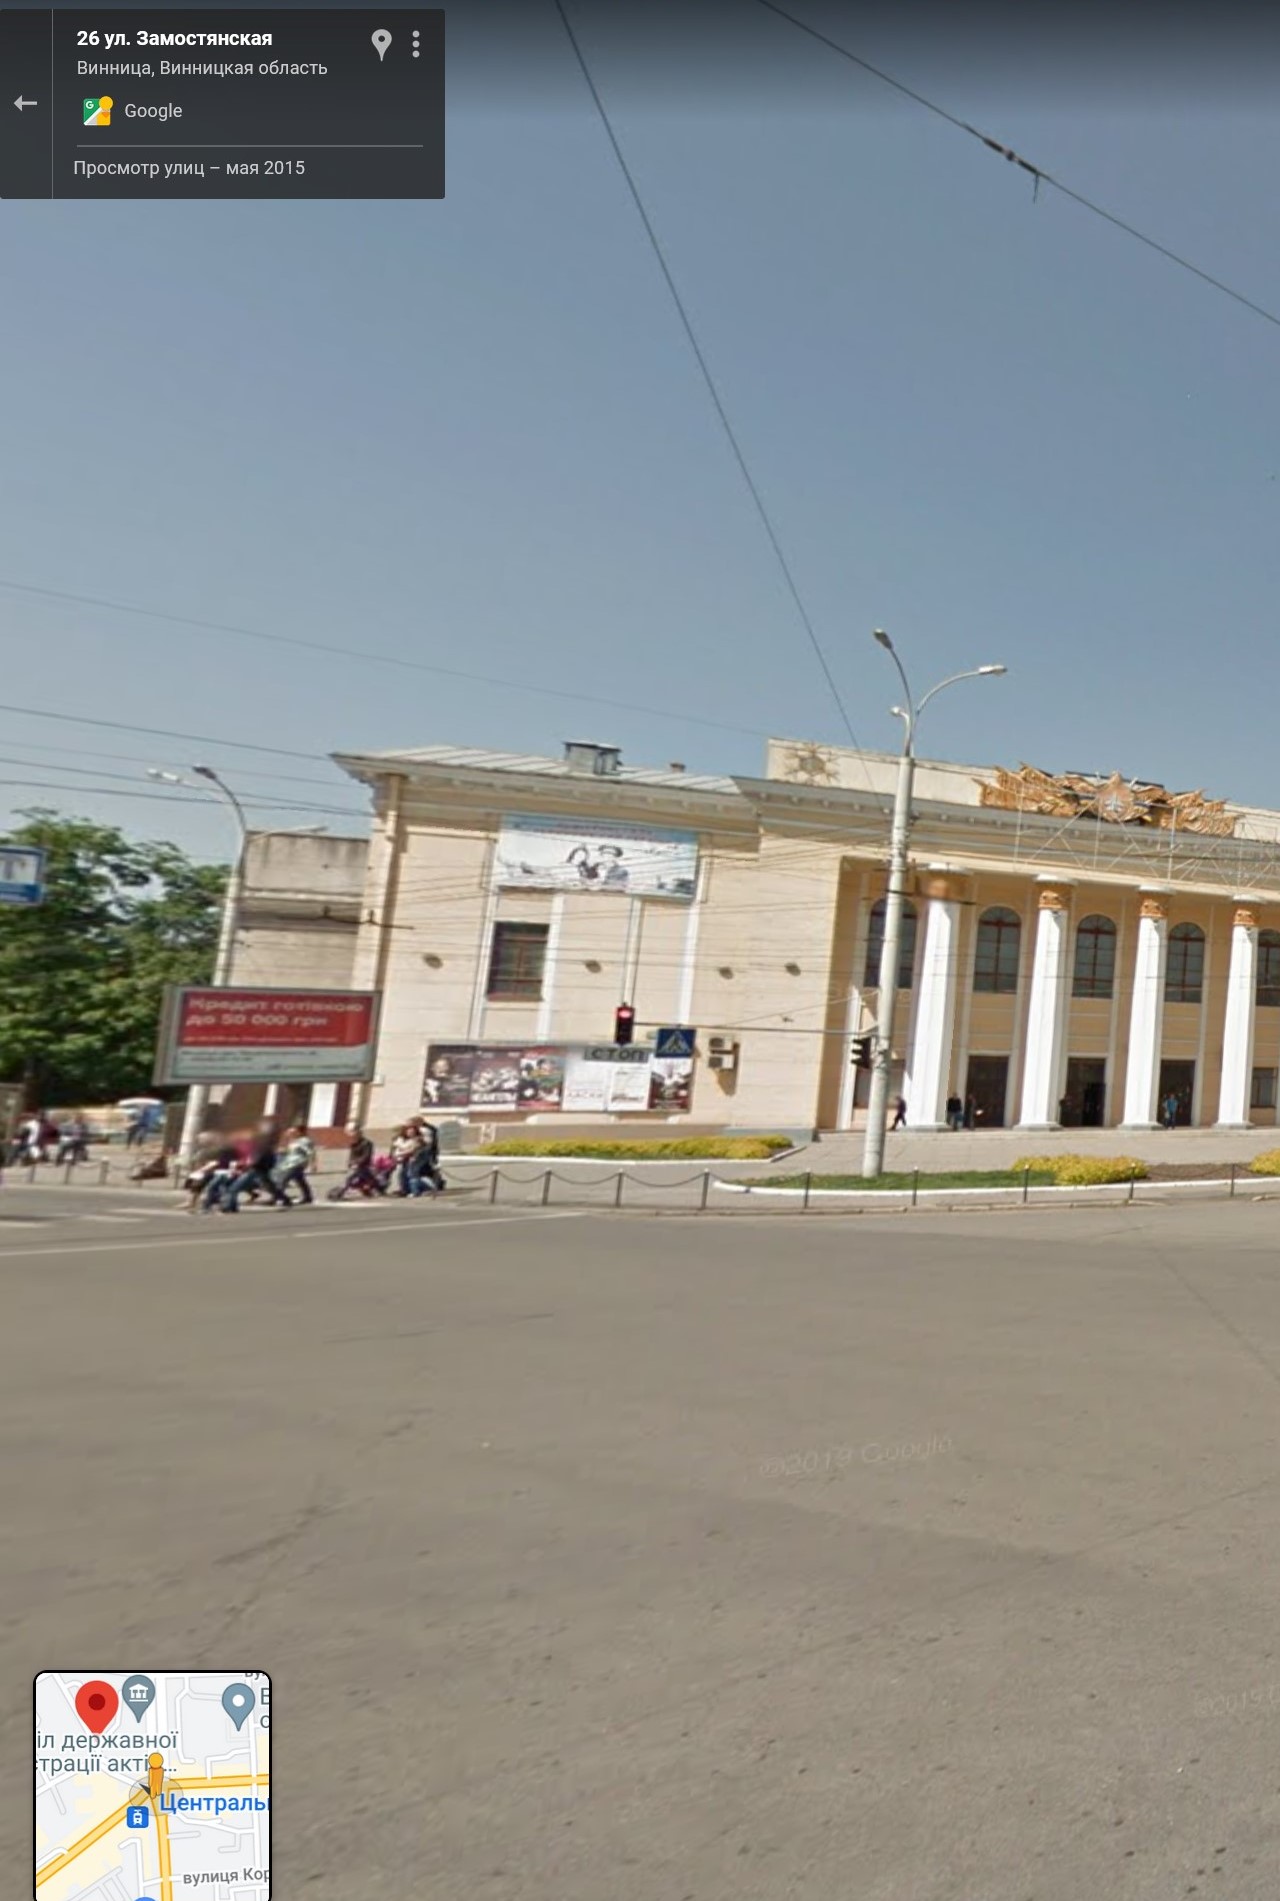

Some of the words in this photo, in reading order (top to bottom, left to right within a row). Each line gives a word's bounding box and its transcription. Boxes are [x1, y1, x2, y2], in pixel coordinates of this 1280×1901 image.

[189, 997, 268, 1012] Кредит
[274, 1001, 364, 1012] готівкою
[186, 1014, 216, 1027] до
[221, 1014, 247, 1026] 50
[251, 1014, 288, 1026] 000
[291, 1016, 328, 1027] грн
